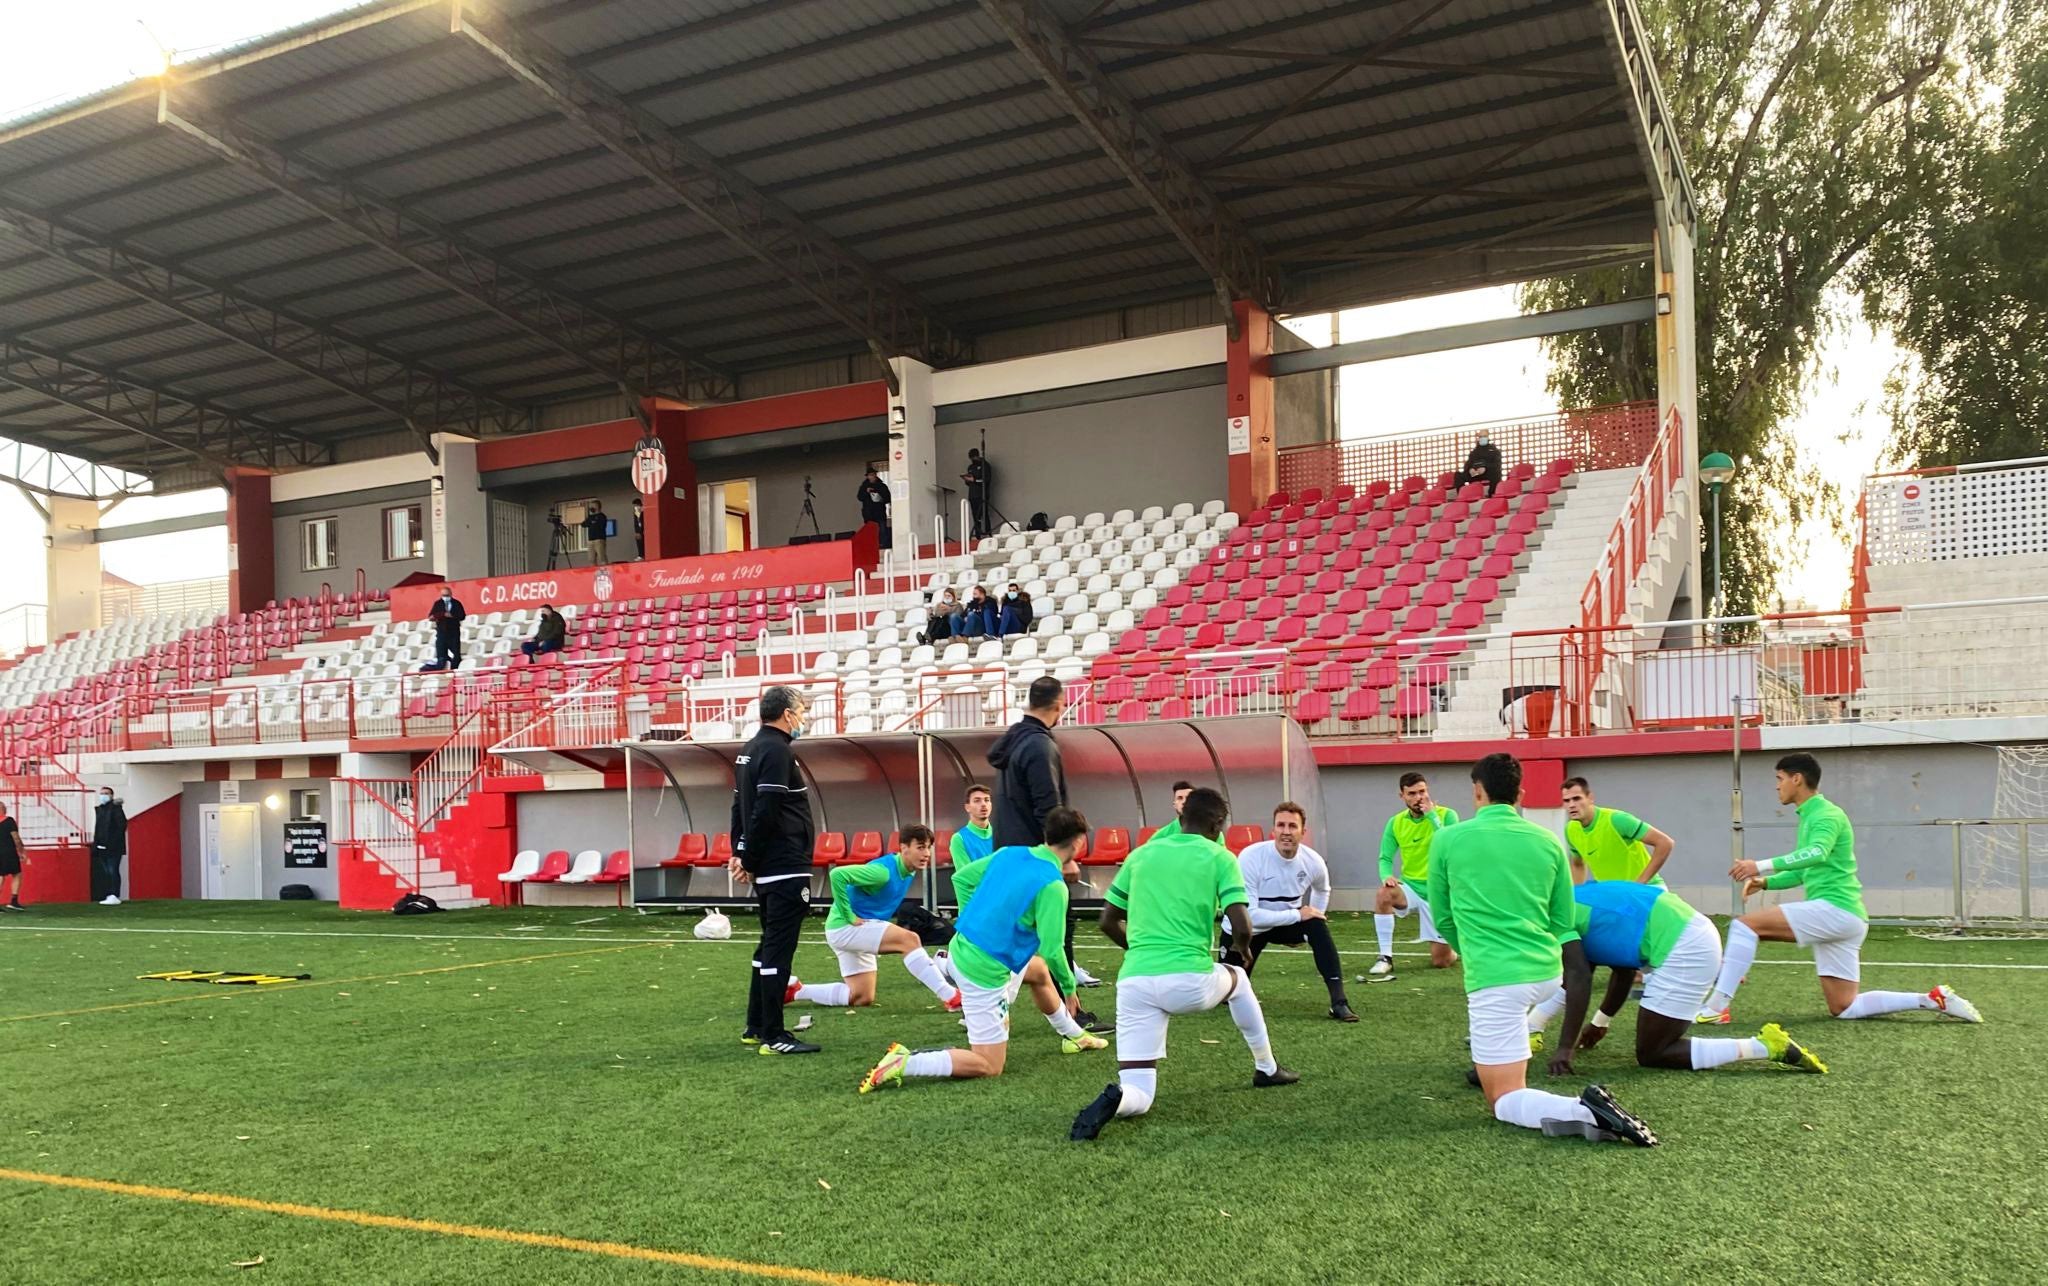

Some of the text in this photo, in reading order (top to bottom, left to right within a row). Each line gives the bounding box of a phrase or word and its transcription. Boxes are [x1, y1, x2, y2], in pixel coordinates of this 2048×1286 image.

[648, 564, 764, 588] Fundado en 1919
[480, 580, 558, 604] C. D. ACERO
